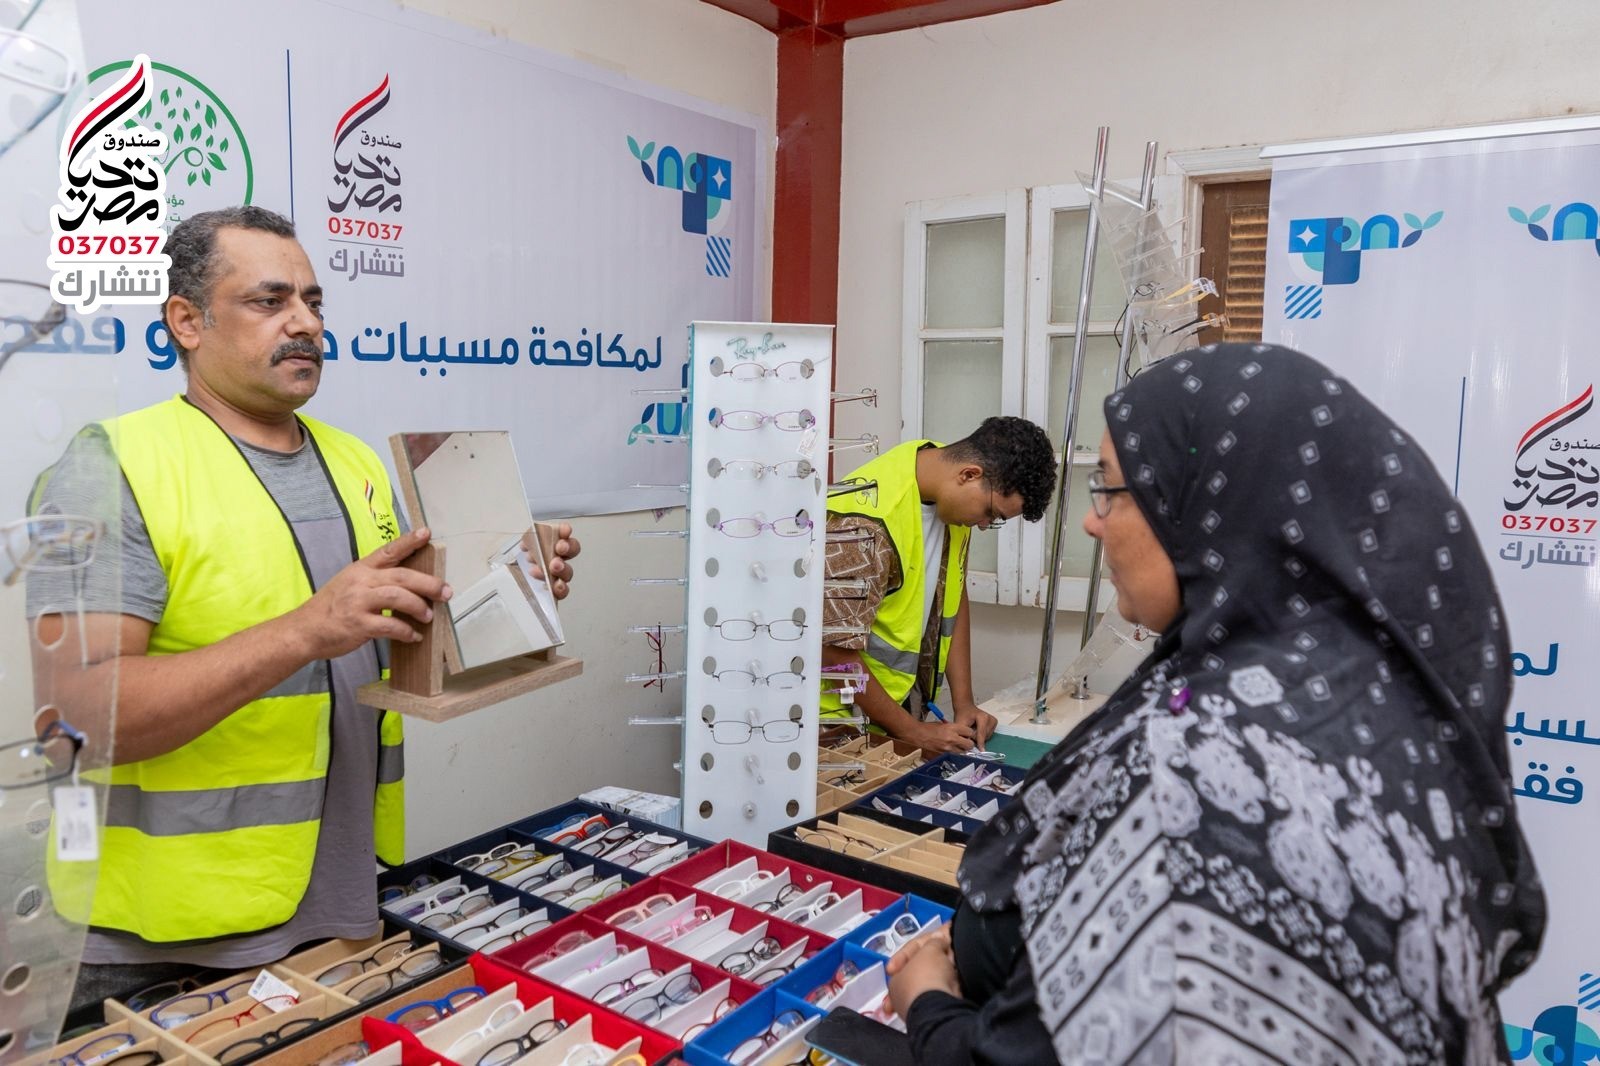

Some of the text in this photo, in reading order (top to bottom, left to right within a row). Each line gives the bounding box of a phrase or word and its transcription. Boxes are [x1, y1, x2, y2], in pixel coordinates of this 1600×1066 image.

[361, 130, 402, 149] صندوق
[328, 216, 403, 241] 037037
[329, 248, 405, 281] نتشارك
[351, 321, 519, 377] مسببات
[529, 326, 662, 372] لمكافحة
[1502, 514, 1598, 534] 037037
[1499, 540, 1597, 569] نتشارك
